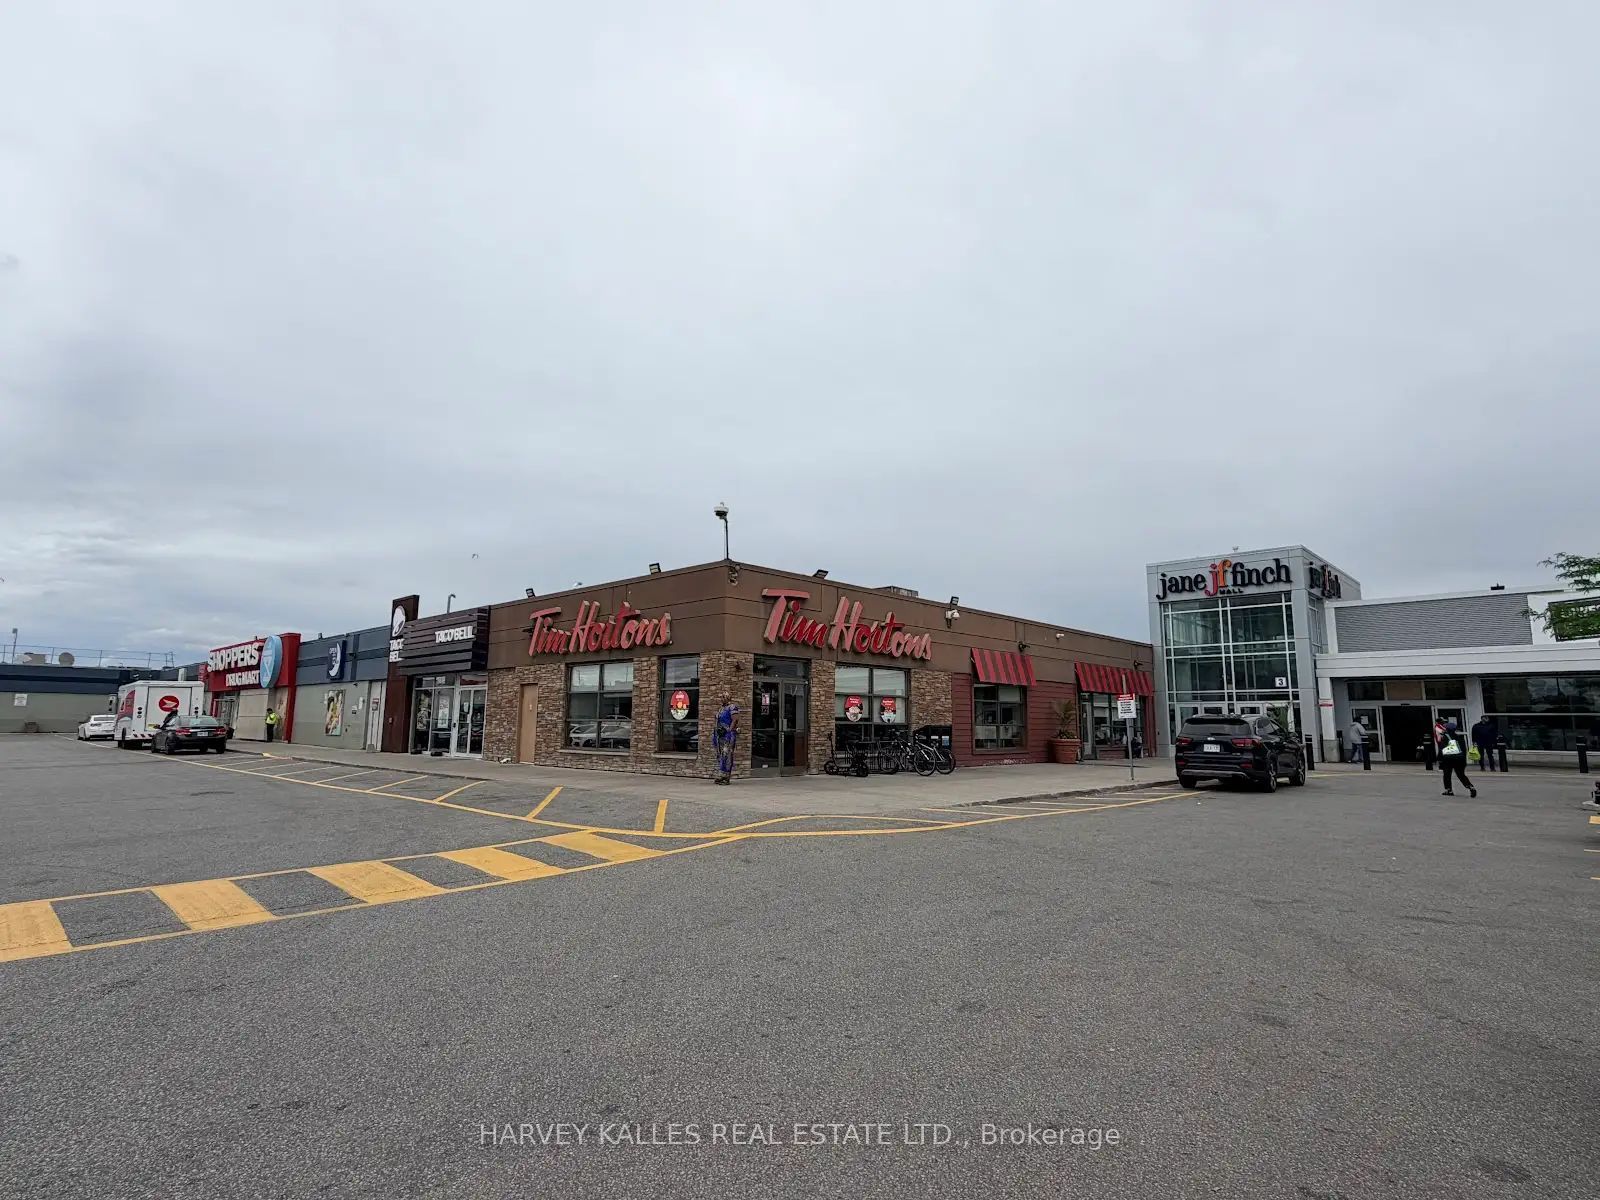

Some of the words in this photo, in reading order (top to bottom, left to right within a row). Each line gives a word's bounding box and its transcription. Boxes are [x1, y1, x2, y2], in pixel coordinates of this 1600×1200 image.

[1156, 573, 1206, 600] jane
[1231, 558, 1292, 587] finch
[435, 629, 455, 643] TACO
[454, 626, 474, 641] BELL
[529, 606, 571, 656] Tim
[568, 600, 671, 652] Hortons
[762, 588, 828, 648] Tim
[829, 596, 932, 661] Hortons
[207, 643, 260, 672] SHOPPERS
[389, 651, 404, 662] BEL
[225, 672, 242, 687] DRUG
[242, 670, 260, 685] MART
[1278, 678, 1284, 686] 3
